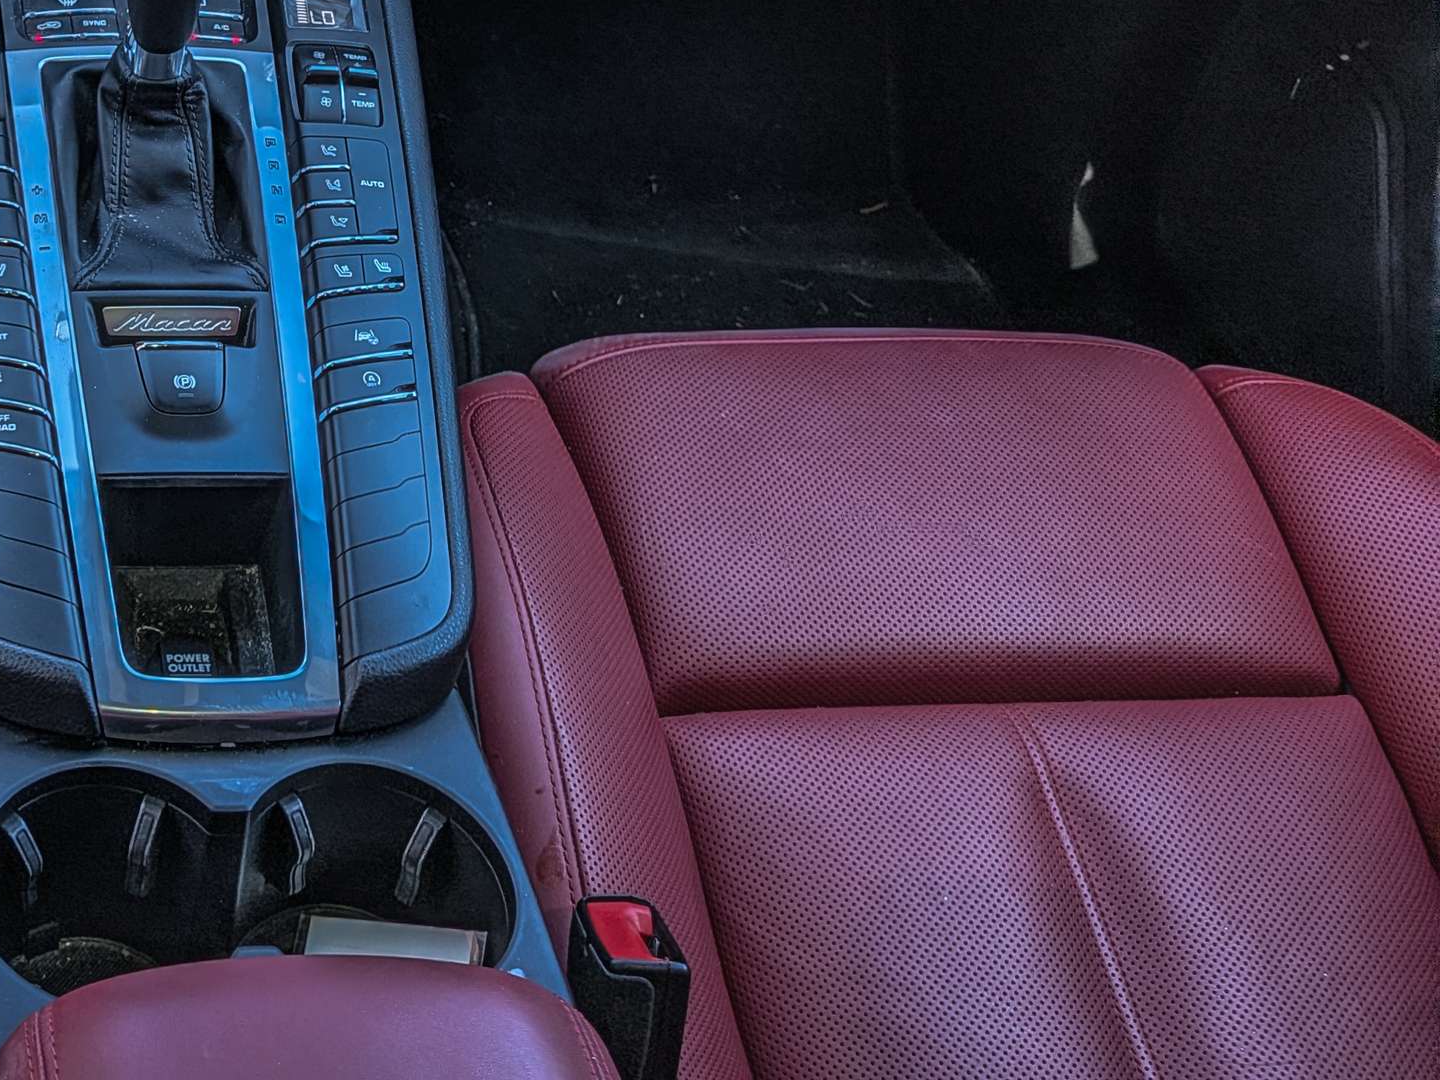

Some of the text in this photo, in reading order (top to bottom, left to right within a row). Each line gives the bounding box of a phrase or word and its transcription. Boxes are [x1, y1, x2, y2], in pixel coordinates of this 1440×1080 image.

[310, 11, 335, 25] LO
[343, 53, 367, 61] TEMP
[351, 100, 375, 108] TEMP
[360, 180, 384, 188] AUTO
[113, 311, 232, 333] Macan
[166, 653, 210, 663] POWER
[168, 664, 211, 673] OUTLET
